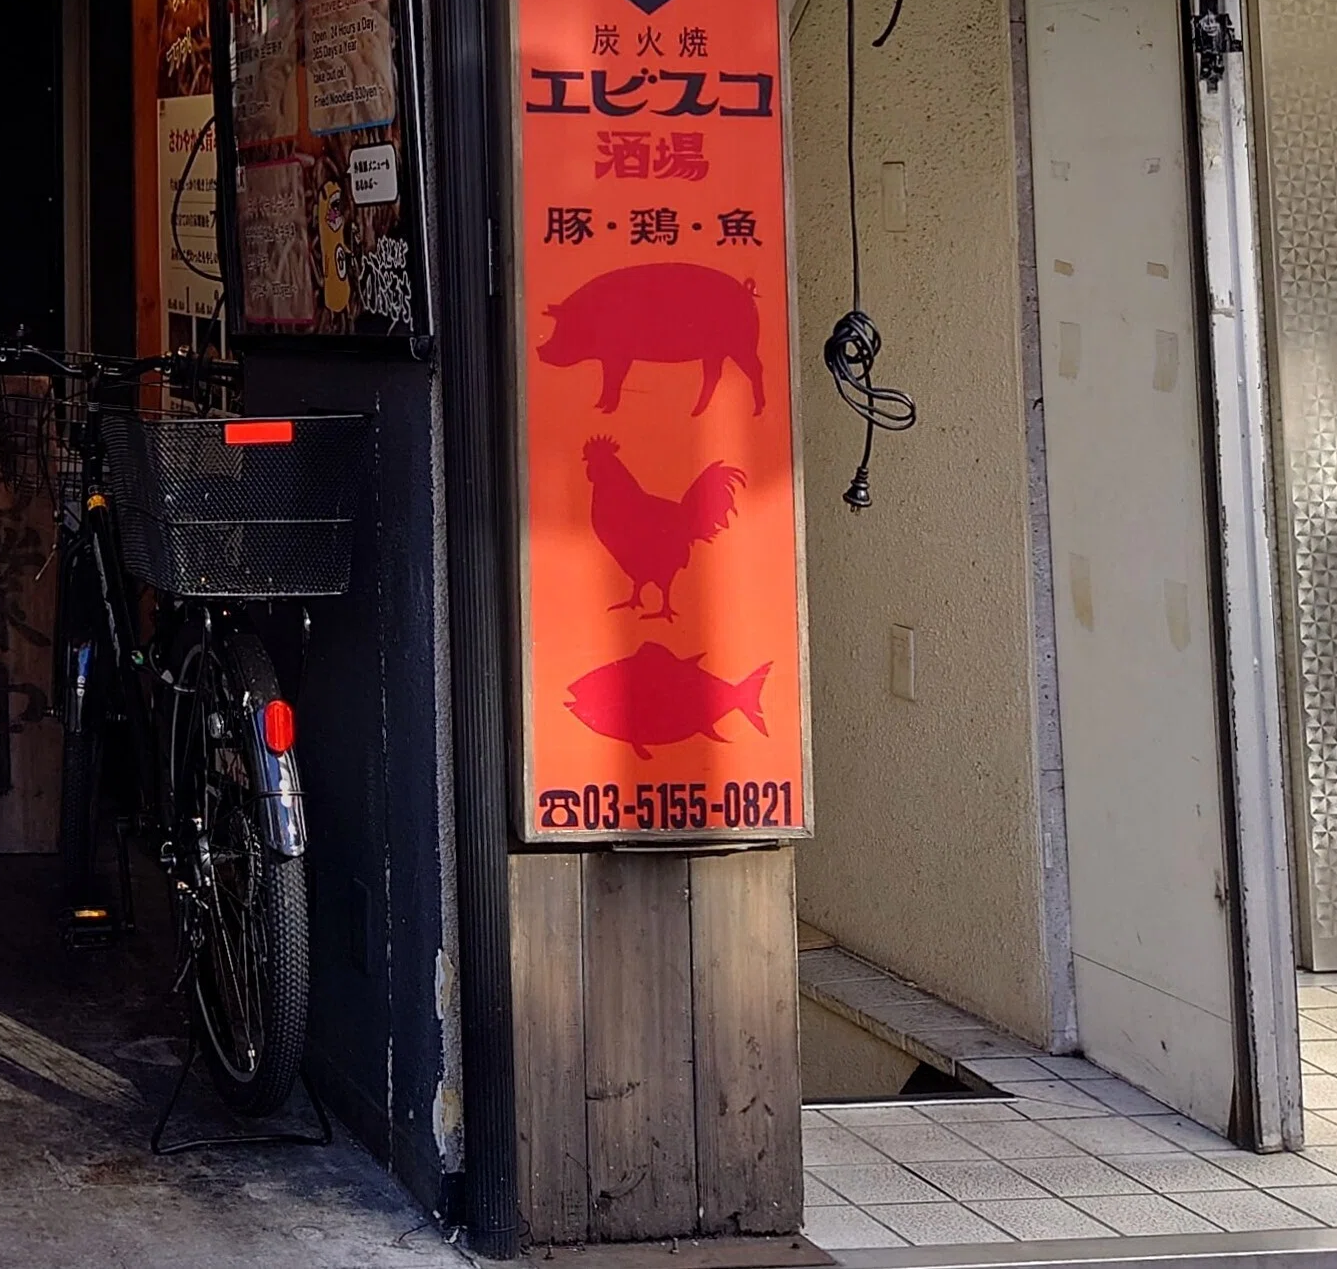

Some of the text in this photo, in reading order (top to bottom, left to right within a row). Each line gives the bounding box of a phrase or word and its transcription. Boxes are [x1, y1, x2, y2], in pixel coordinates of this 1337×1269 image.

[592, 25, 709, 57] 炭火焼
[526, 68, 774, 118] エビスコ
[595, 132, 710, 182] 酒場
[543, 207, 763, 247] 豚・鶏・魚
[583, 781, 792, 830] 03-5155-0821
